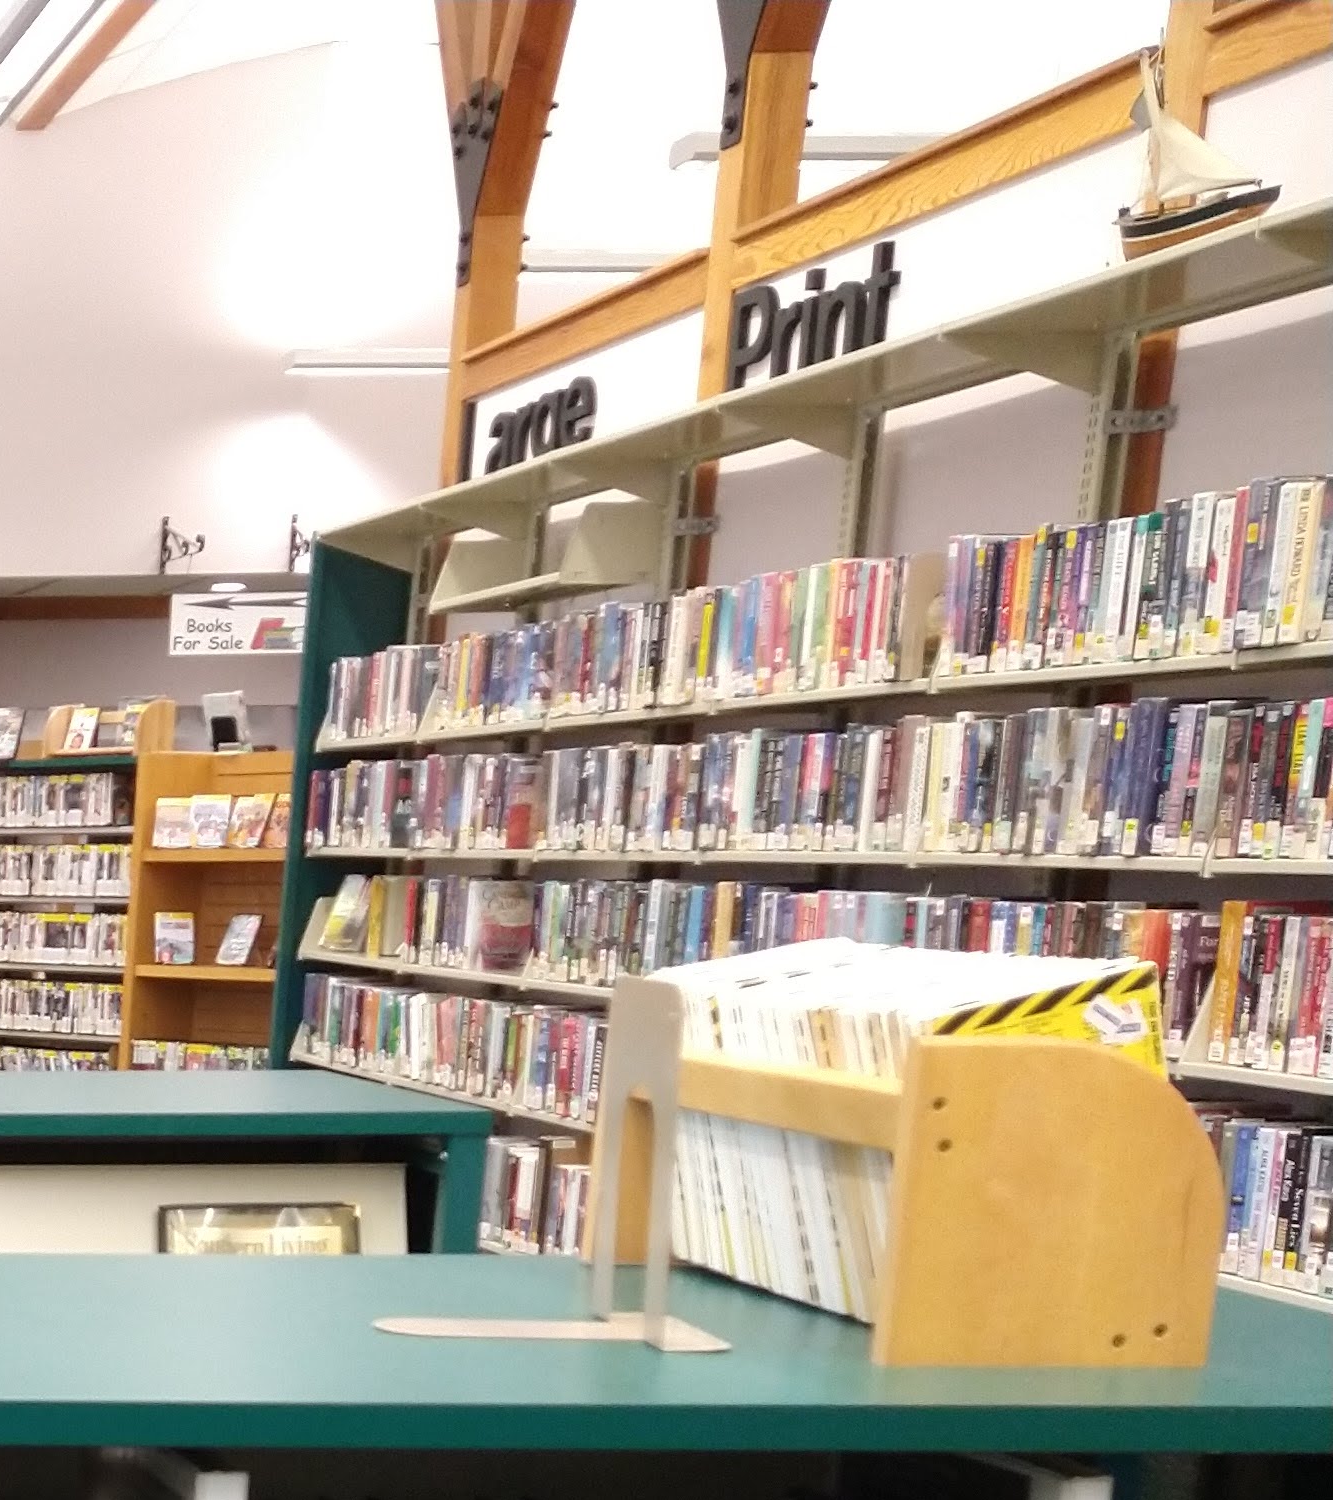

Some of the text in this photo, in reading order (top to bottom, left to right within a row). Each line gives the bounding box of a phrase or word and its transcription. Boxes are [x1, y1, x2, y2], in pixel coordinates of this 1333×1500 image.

[725, 241, 901, 393] Print
[186, 618, 232, 633] Books
[173, 635, 243, 650] For Sale
